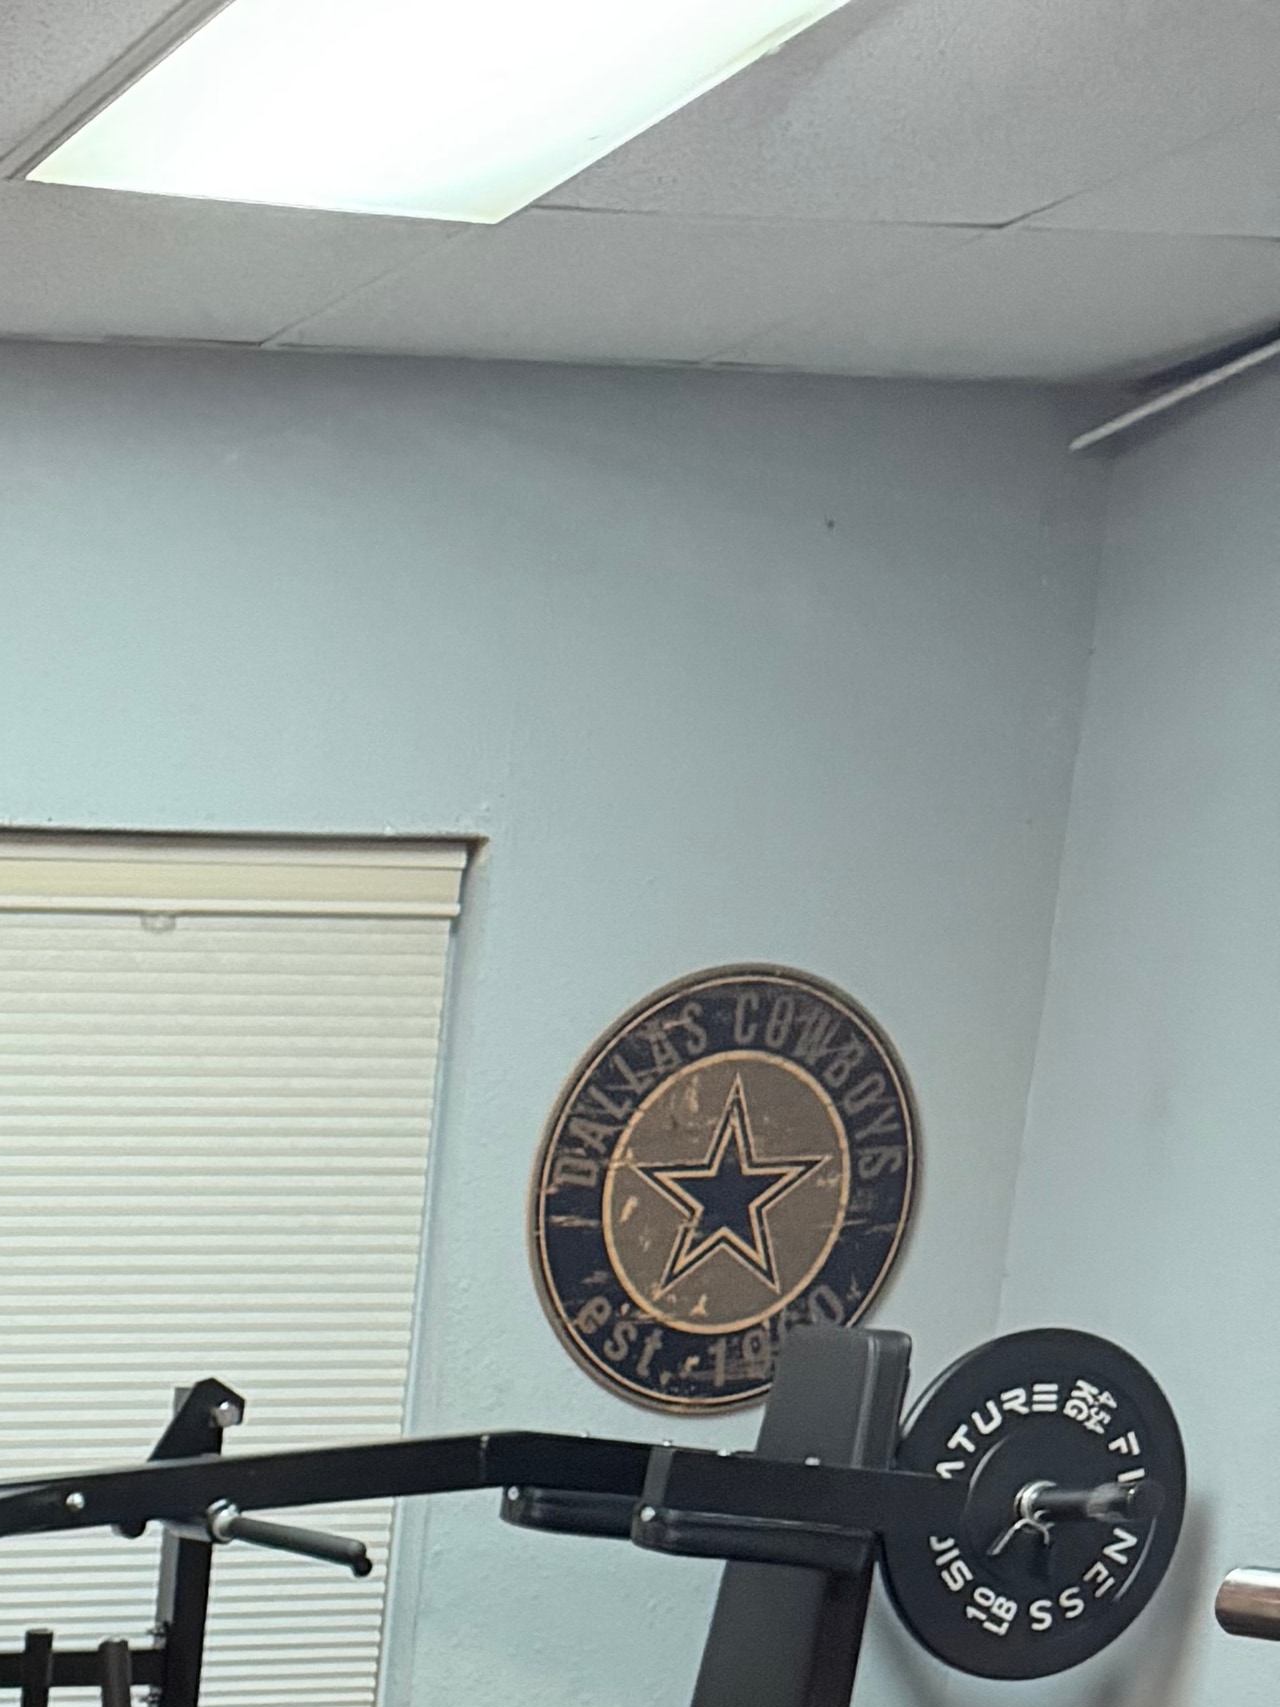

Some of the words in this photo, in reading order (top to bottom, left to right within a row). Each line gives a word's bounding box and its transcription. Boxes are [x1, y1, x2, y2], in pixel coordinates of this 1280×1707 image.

[555, 1001, 708, 1188] DALLAS
[732, 990, 904, 1180] COWBOYS
[711, 1284, 845, 1388] 190
[1063, 1379, 1099, 1422] KG
[964, 1586, 997, 1622] 10
[983, 1598, 1019, 1637] LB
